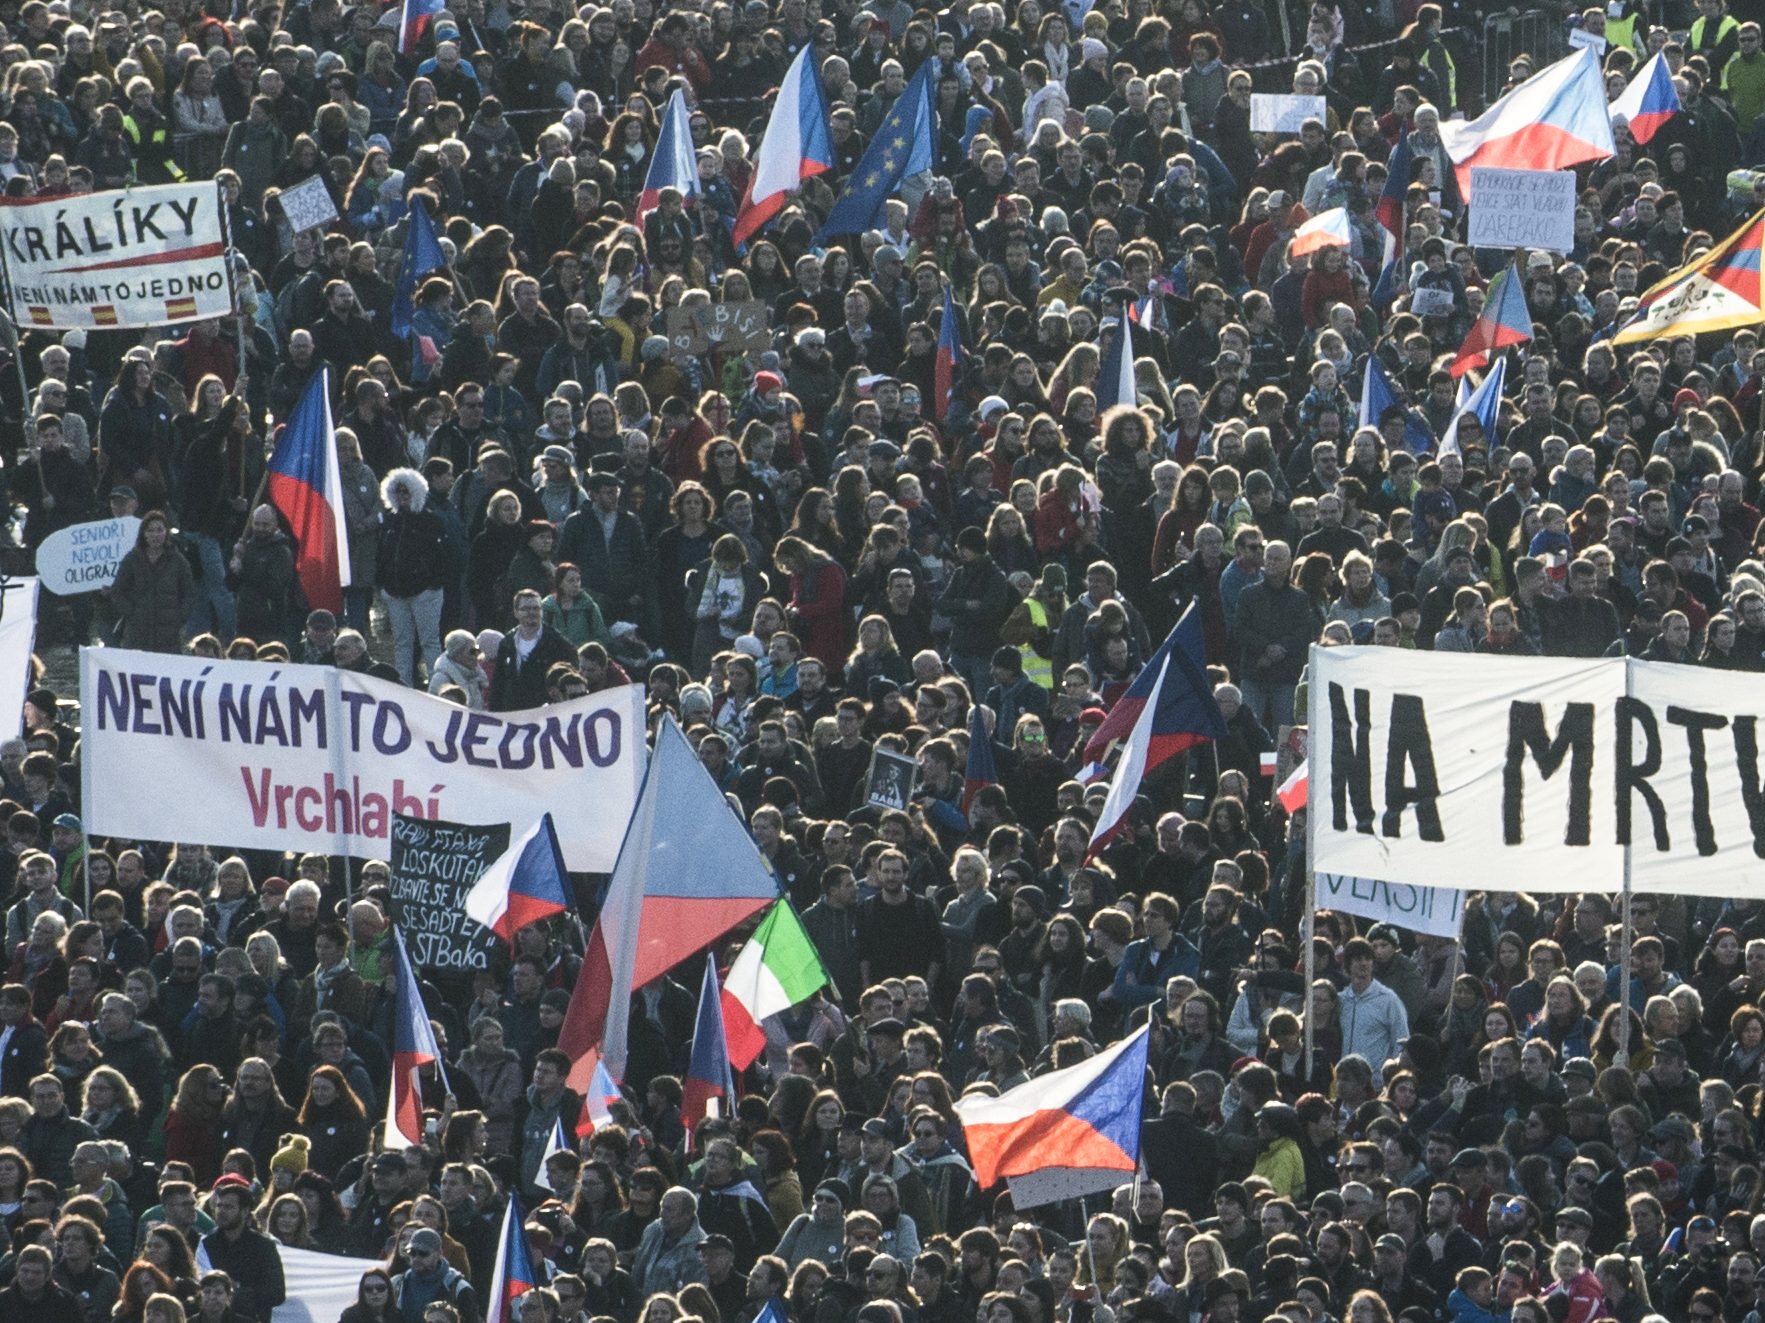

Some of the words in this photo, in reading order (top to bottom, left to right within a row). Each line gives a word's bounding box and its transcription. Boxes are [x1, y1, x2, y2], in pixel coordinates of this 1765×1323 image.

[4, 197, 199, 263] KRÁLÍKY
[53, 282, 99, 305] NÁM
[100, 282, 131, 301] TO
[136, 271, 223, 298] JEDNO
[97, 666, 213, 741] NENÍ
[218, 671, 328, 749] NÁM
[340, 691, 412, 756] TO
[426, 706, 622, 770] JEDNO
[1328, 681, 1447, 843] NA
